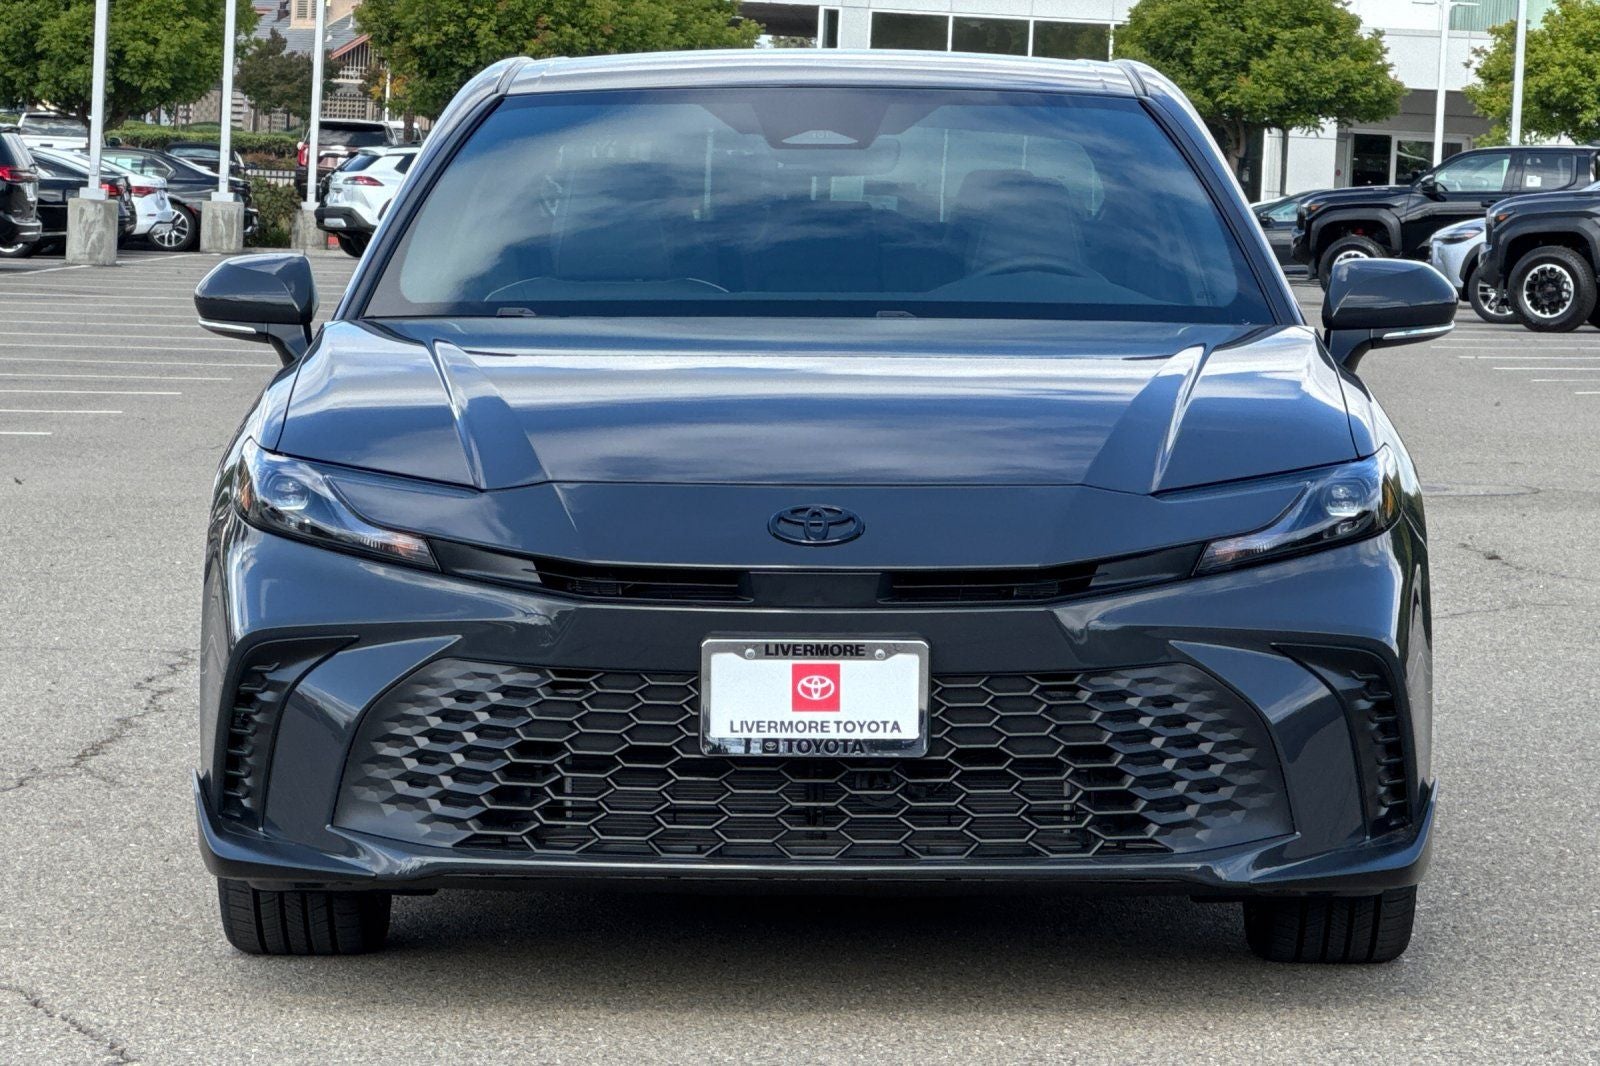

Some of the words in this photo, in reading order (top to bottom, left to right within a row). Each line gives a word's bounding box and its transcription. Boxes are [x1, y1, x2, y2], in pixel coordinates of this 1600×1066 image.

[764, 643, 866, 657] LIVERMORE
[729, 720, 831, 734] LIVERMORE
[836, 720, 902, 734] TOYOTA
[785, 739, 865, 754] TOYOTA
